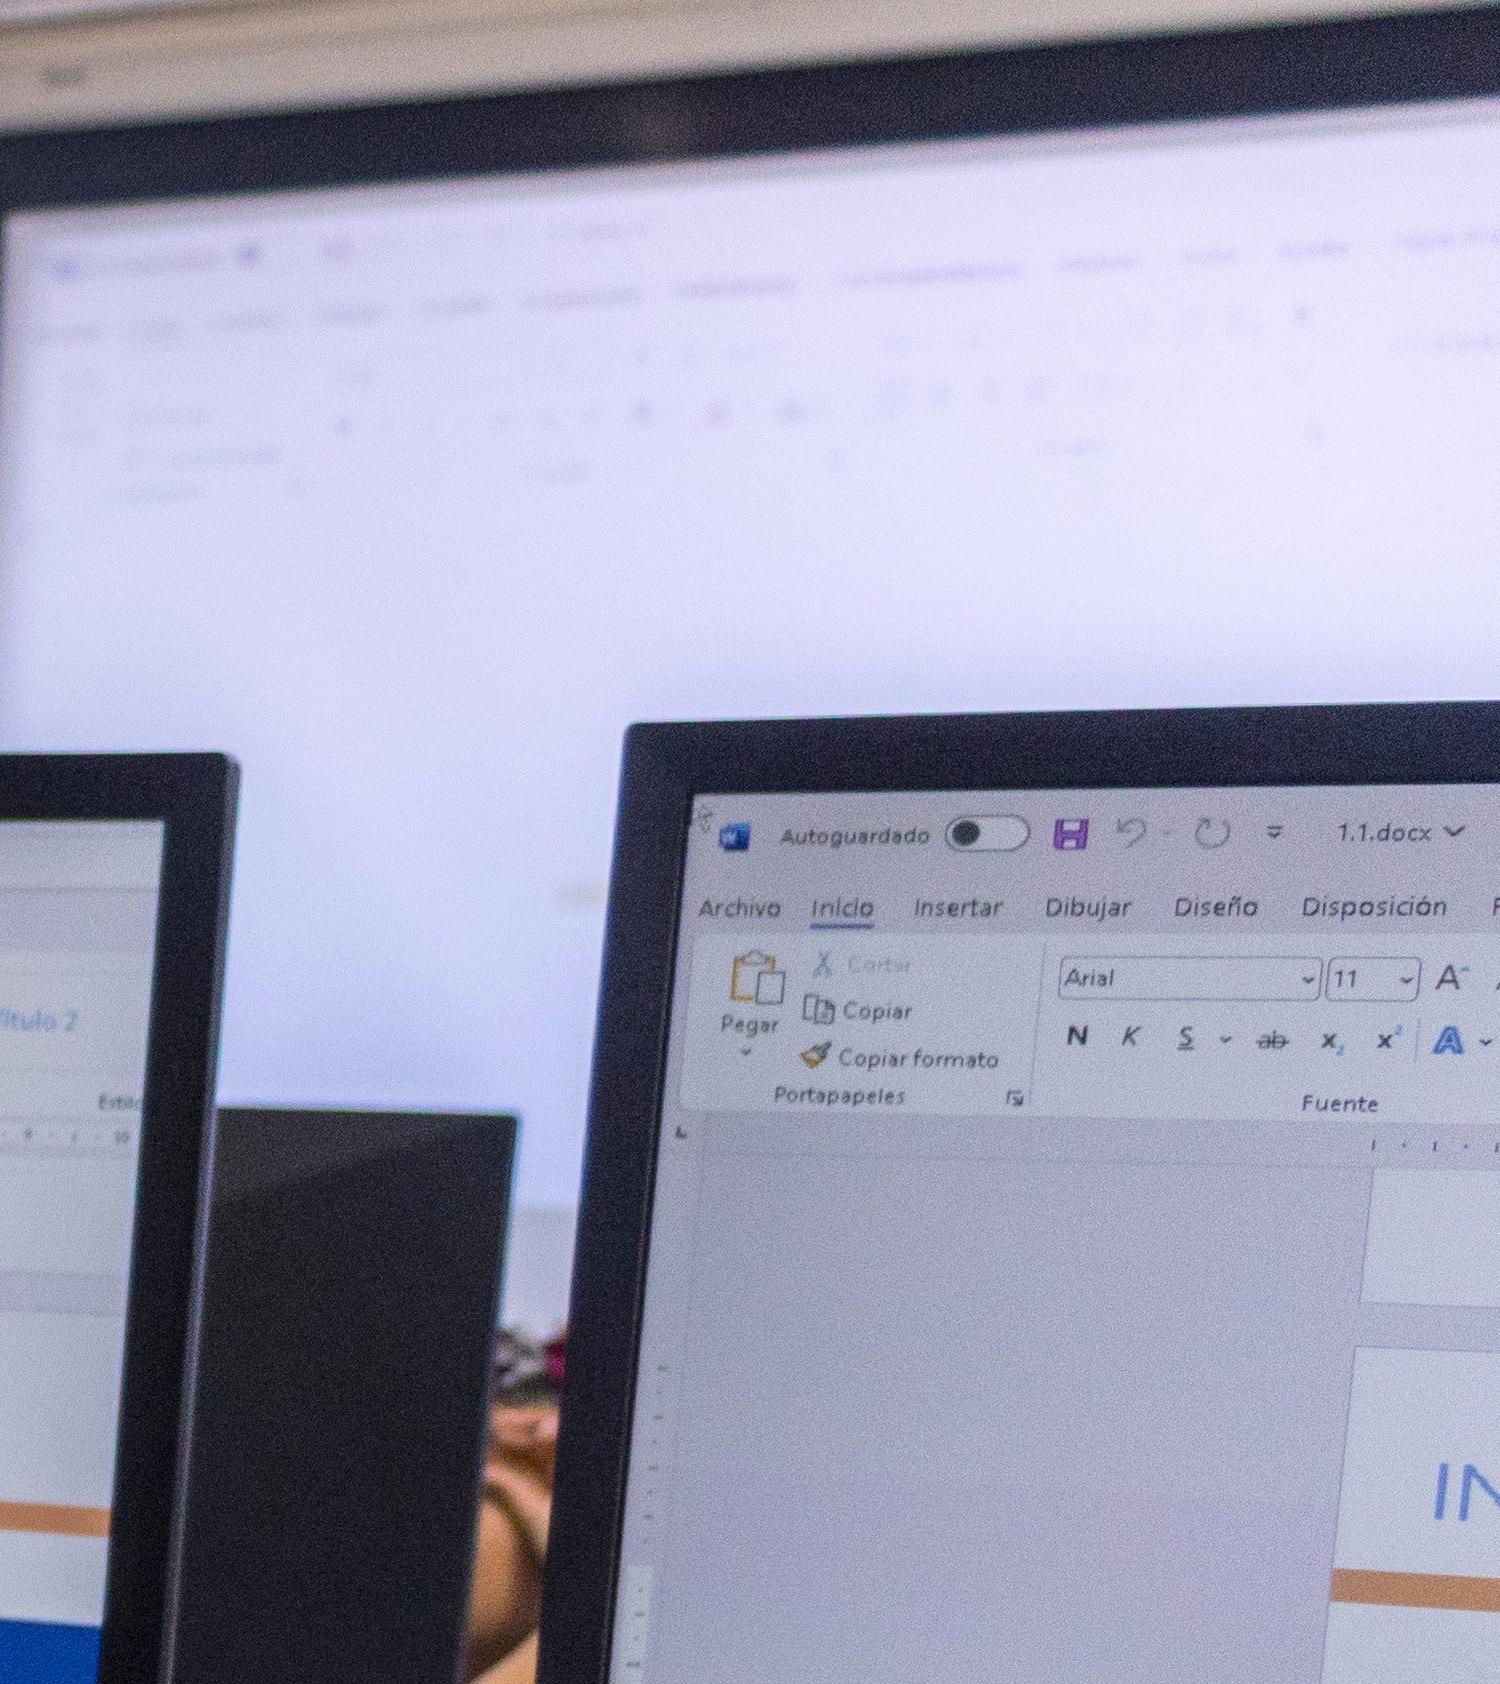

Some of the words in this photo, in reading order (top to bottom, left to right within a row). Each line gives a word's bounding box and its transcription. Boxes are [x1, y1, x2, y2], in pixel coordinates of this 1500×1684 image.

[779, 826, 930, 848] Autoguardado
[1337, 822, 1433, 843] 1.1.docx
[698, 898, 782, 919] Archivo
[810, 898, 875, 919] Inicio
[913, 898, 1004, 919] Insertar
[1045, 897, 1133, 923] Dibujar
[1173, 895, 1259, 919] Diseño
[1302, 896, 1447, 922] Disposición
[1063, 967, 1115, 989] Arial
[1334, 970, 1358, 989] 11
[843, 1003, 913, 1025] Copiar
[720, 1013, 779, 1039] Pegar
[838, 1049, 908, 1071] Copiar
[913, 1049, 1000, 1070] formato
[773, 1085, 907, 1107] Portapapeles
[1300, 1094, 1380, 1115] Fuente
[1433, 1461, 1500, 1523] IN
